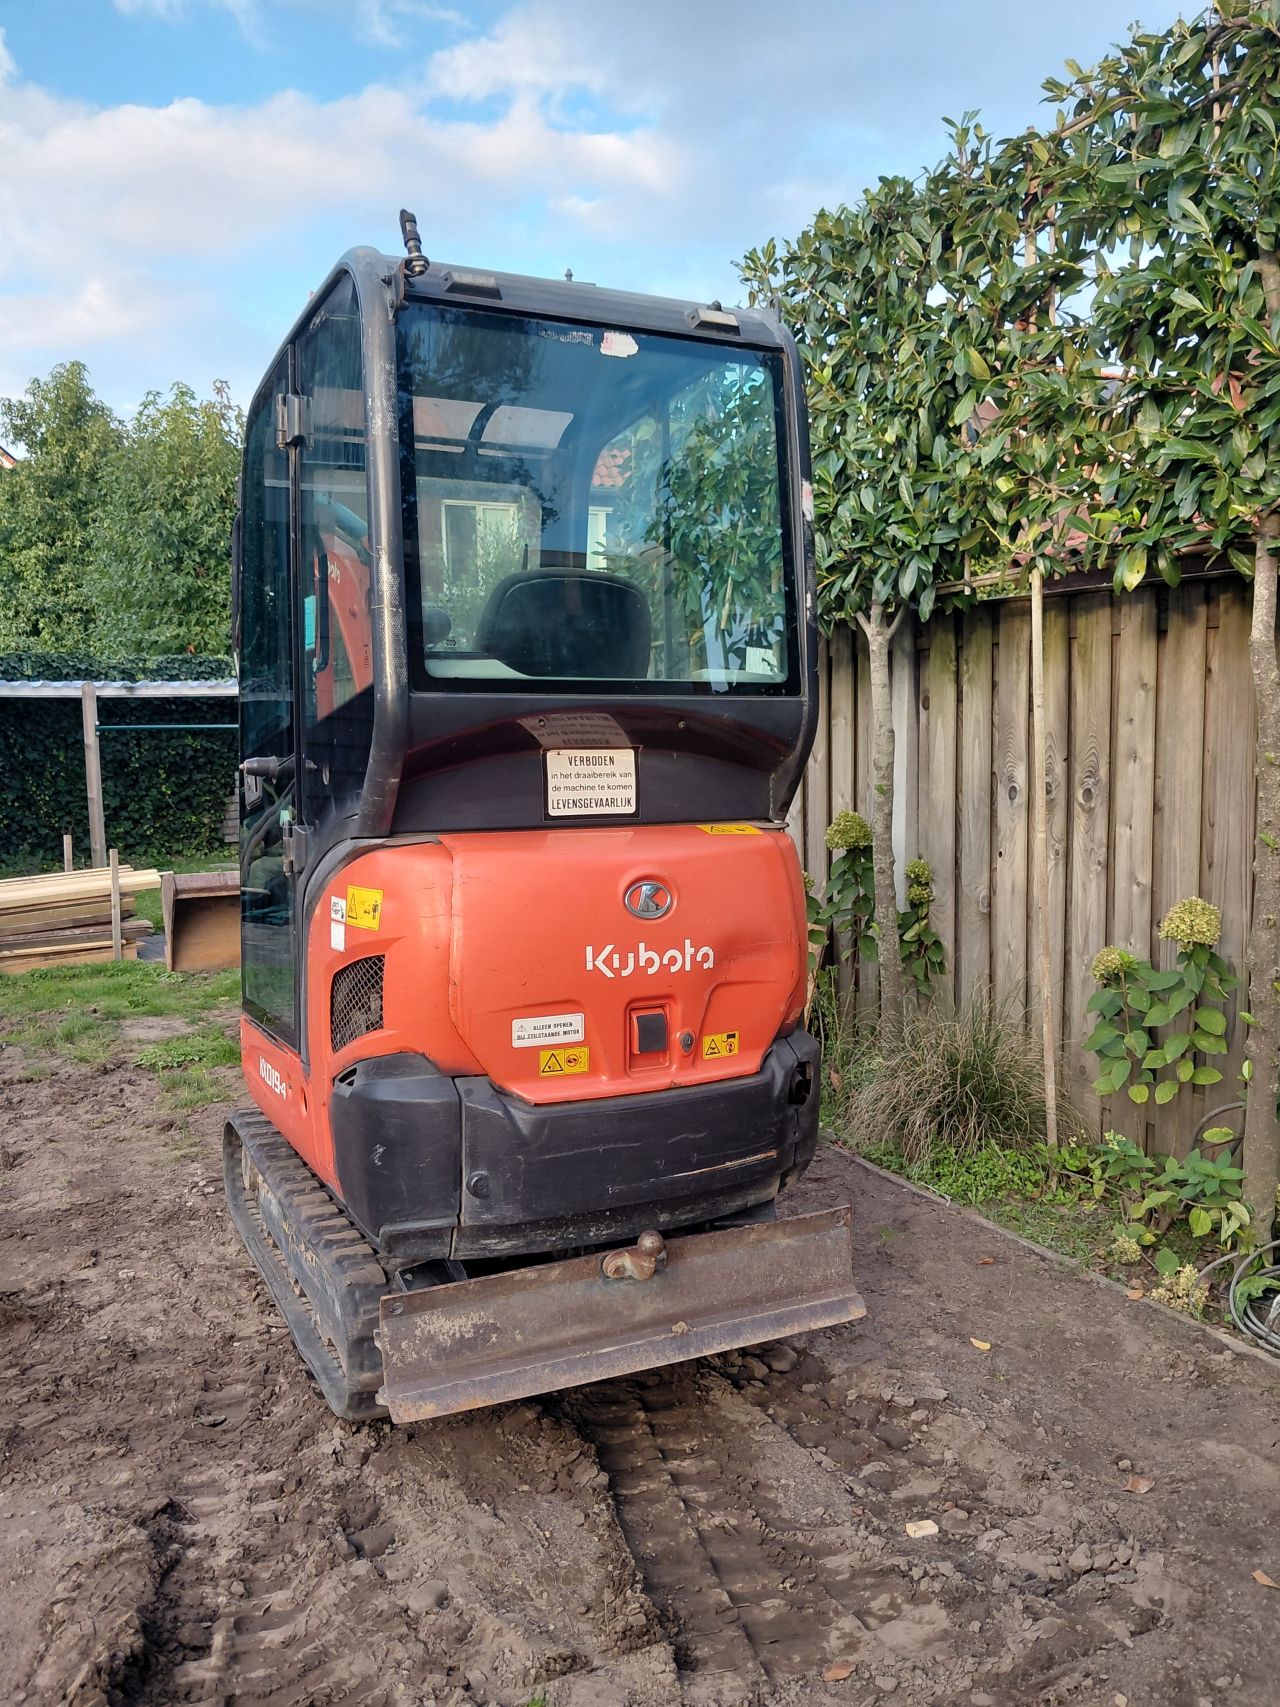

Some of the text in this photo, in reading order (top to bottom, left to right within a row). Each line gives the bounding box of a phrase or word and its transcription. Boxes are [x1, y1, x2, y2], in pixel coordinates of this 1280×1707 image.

[567, 755, 615, 767] VERBODEN
[559, 771, 572, 779] het
[574, 771, 617, 779] draaibereik
[551, 784, 562, 792] de
[563, 783, 596, 791] machine
[607, 783, 633, 791] komen
[551, 797, 633, 810] LEVENSGEVAARLIJK
[585, 938, 715, 978] Kubota
